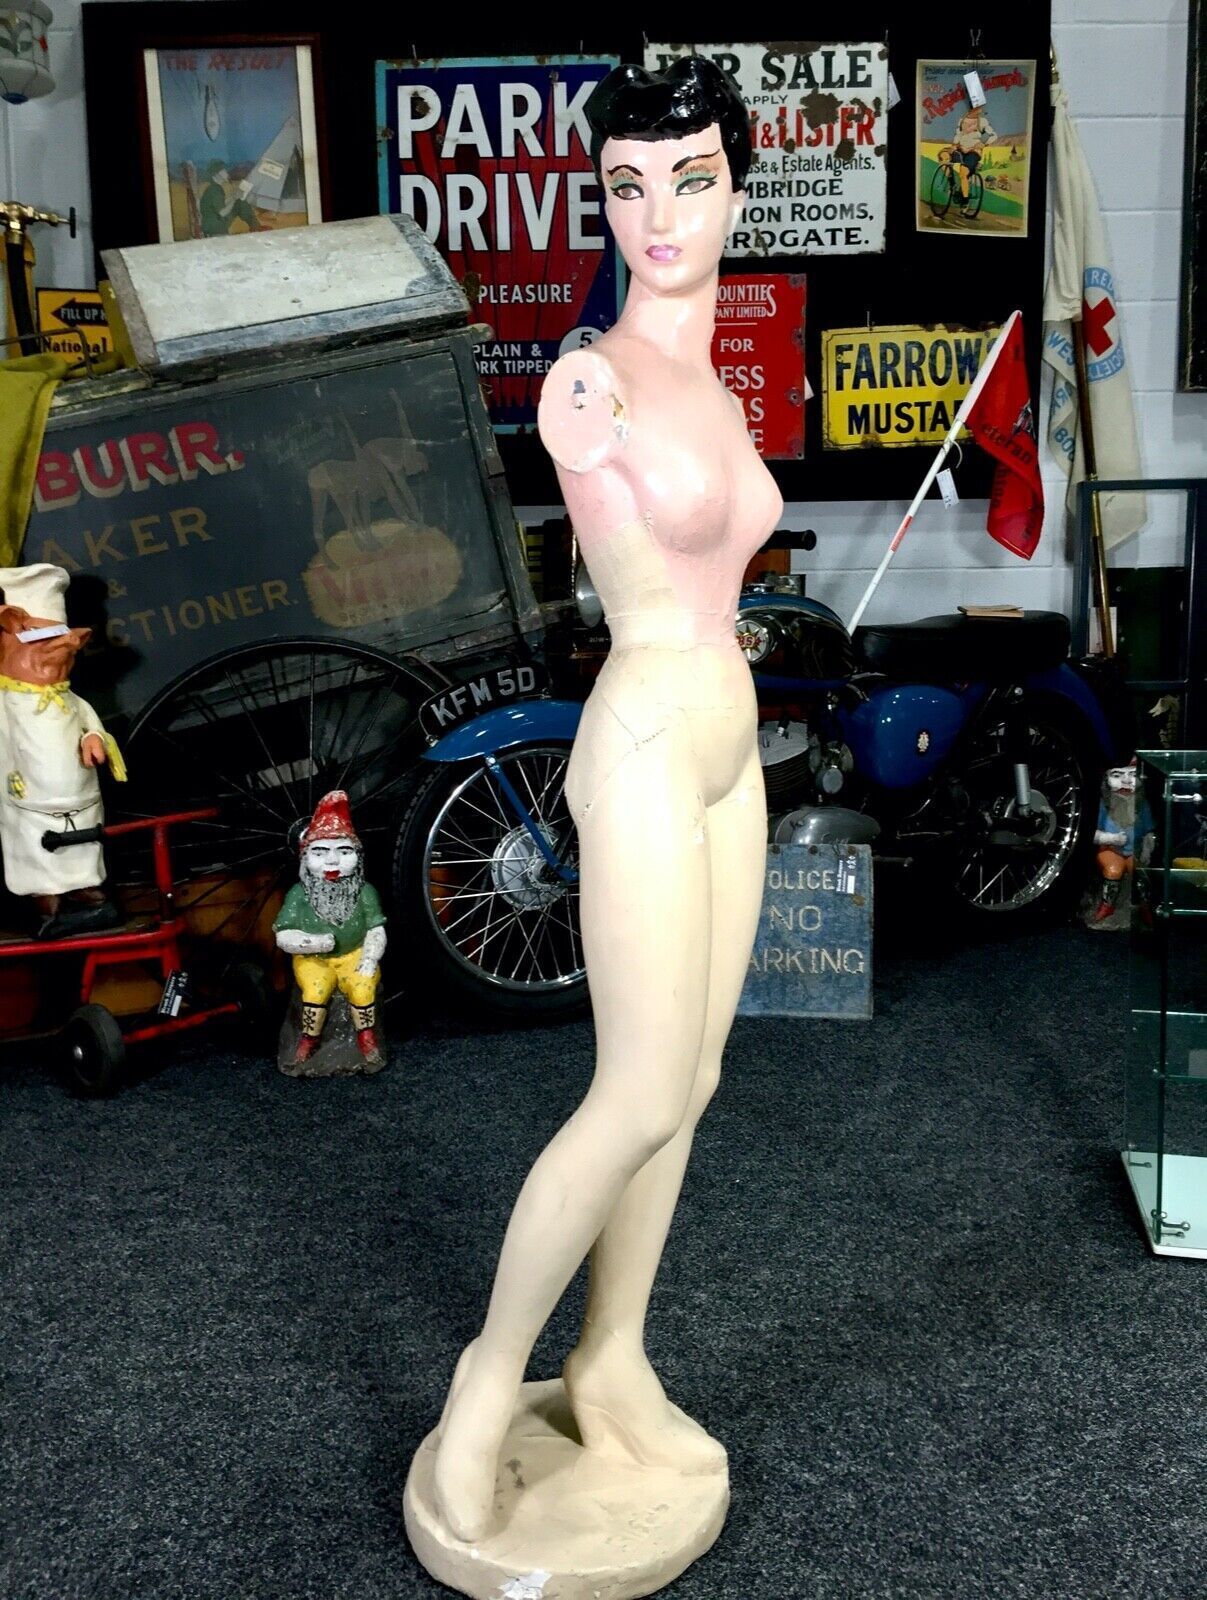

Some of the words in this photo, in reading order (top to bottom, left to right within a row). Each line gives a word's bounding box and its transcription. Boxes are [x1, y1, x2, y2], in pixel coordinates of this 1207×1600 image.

[656, 53, 743, 91] FR
[761, 50, 873, 91] SALE
[742, 94, 789, 105] APPLY
[397, 80, 599, 159] PARK
[770, 162, 779, 175] &
[782, 154, 823, 174] Estate
[825, 153, 876, 177] Agents.
[744, 178, 844, 200] MBRIDGE
[400, 172, 606, 251] DRIVE
[741, 206, 782, 224] ION
[791, 203, 875, 222] ROOMS,
[726, 226, 870, 250] ROGATE.
[478, 284, 573, 304] PLEASURE
[718, 284, 778, 317] OUNTIES
[61, 307, 81, 320] FILL
[84, 308, 98, 320] UP
[714, 306, 735, 319] PANY
[736, 305, 767, 318] LIMITED
[472, 343, 521, 358] PLAIN
[531, 343, 542, 358] &
[579, 332, 592, 348] 5
[719, 338, 755, 353] FOR
[503, 359, 553, 375] TIPPED
[719, 365, 765, 391] ESS
[34, 420, 246, 512] BURR.
[40, 506, 215, 572] AKER
[107, 577, 129, 598] &
[105, 579, 300, 648] CTIONER.
[430, 677, 493, 727] KFM
[497, 666, 536, 696] 5D
[768, 870, 835, 891] OLICE
[769, 904, 822, 931] NO
[748, 948, 866, 974] ARKING
